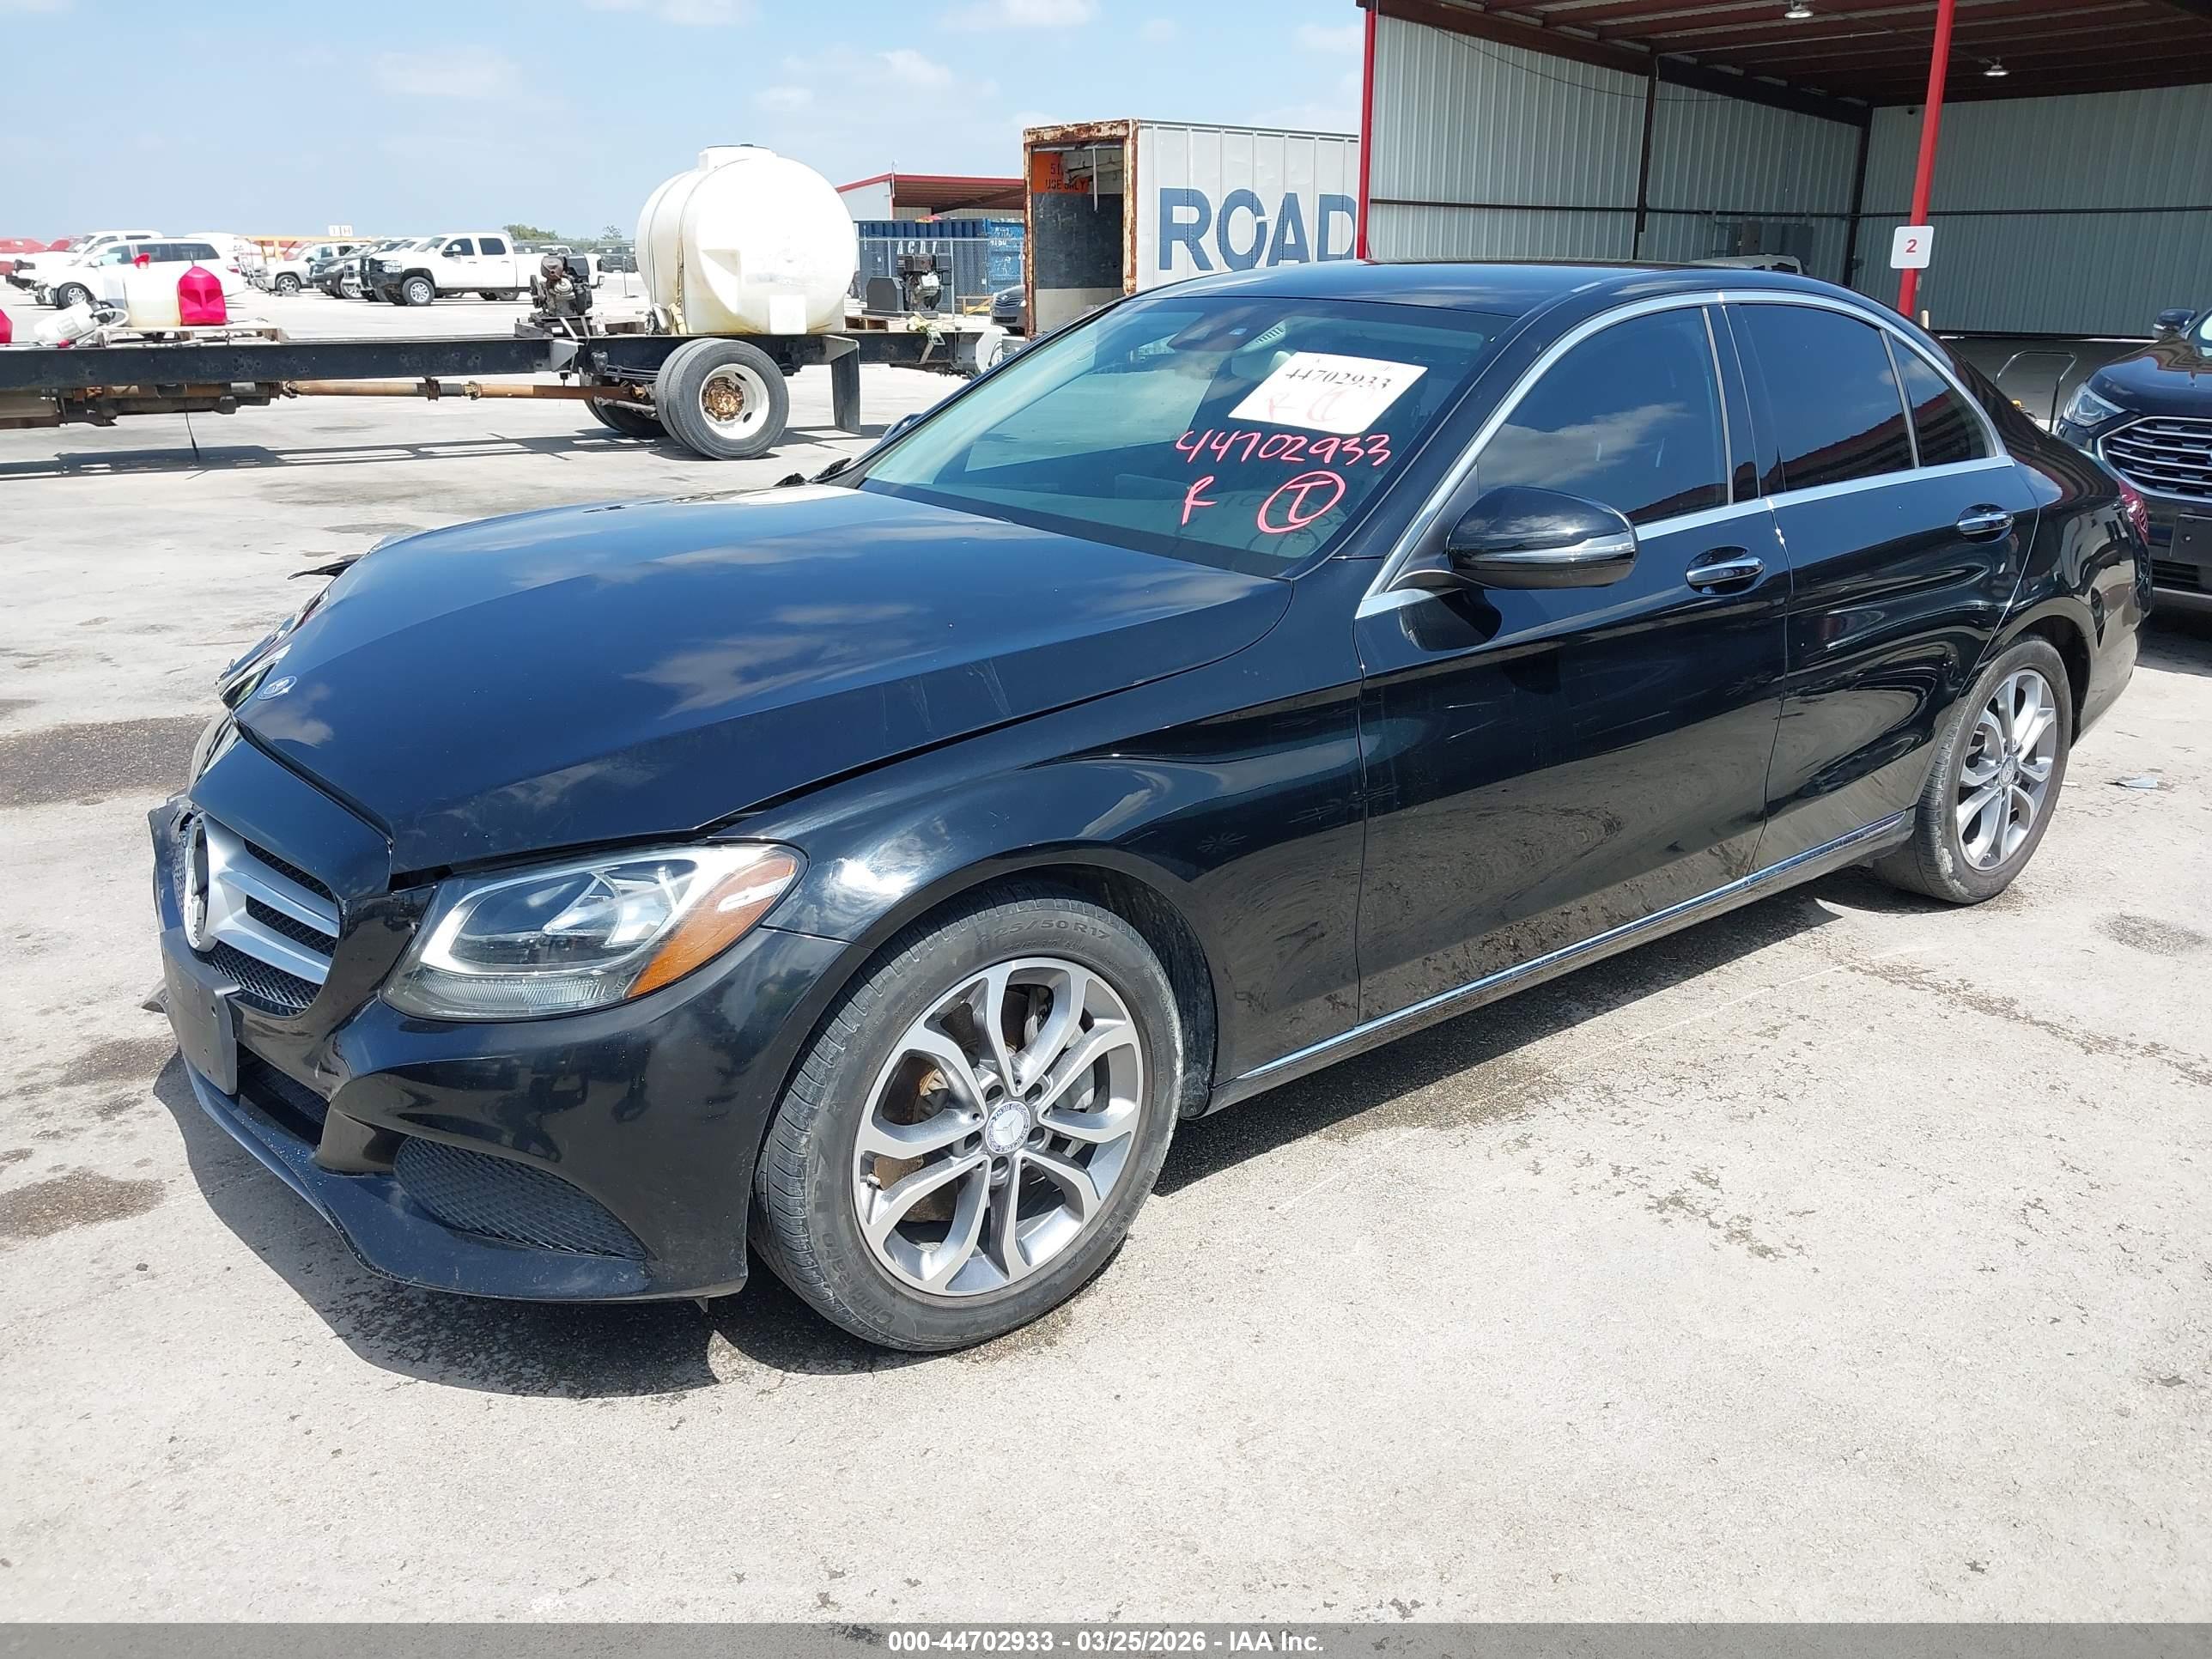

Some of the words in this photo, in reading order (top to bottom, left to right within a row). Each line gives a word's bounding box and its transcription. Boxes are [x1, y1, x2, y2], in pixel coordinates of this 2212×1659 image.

[1159, 187, 1358, 271] ROAD
[1905, 239, 1917, 253] 2
[1175, 428, 1392, 466] 44702933
